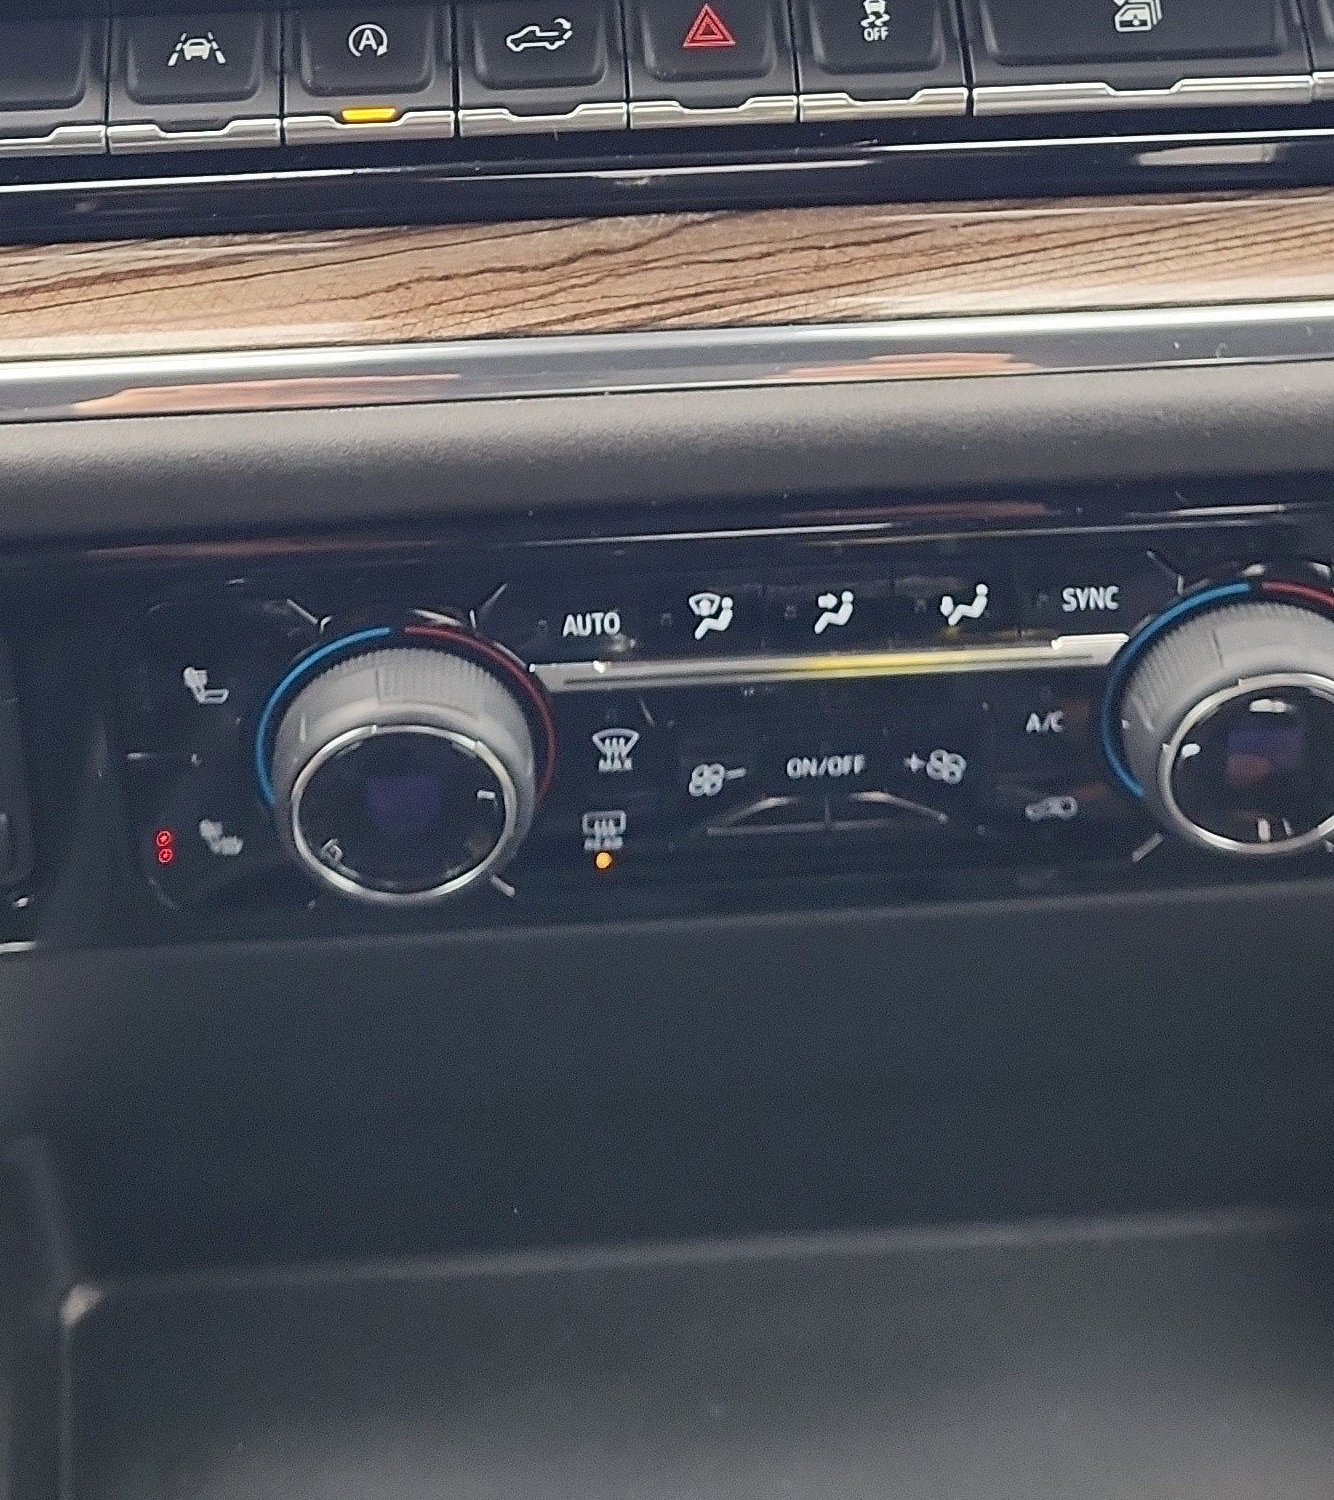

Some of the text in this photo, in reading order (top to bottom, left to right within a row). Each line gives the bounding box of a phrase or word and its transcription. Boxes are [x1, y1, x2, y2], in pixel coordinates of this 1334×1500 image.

[864, 26, 889, 41] OFF
[563, 586, 1120, 638] AUTO SYNC
[1025, 710, 1065, 735] A/C
[786, 753, 866, 780] ON/OFF
